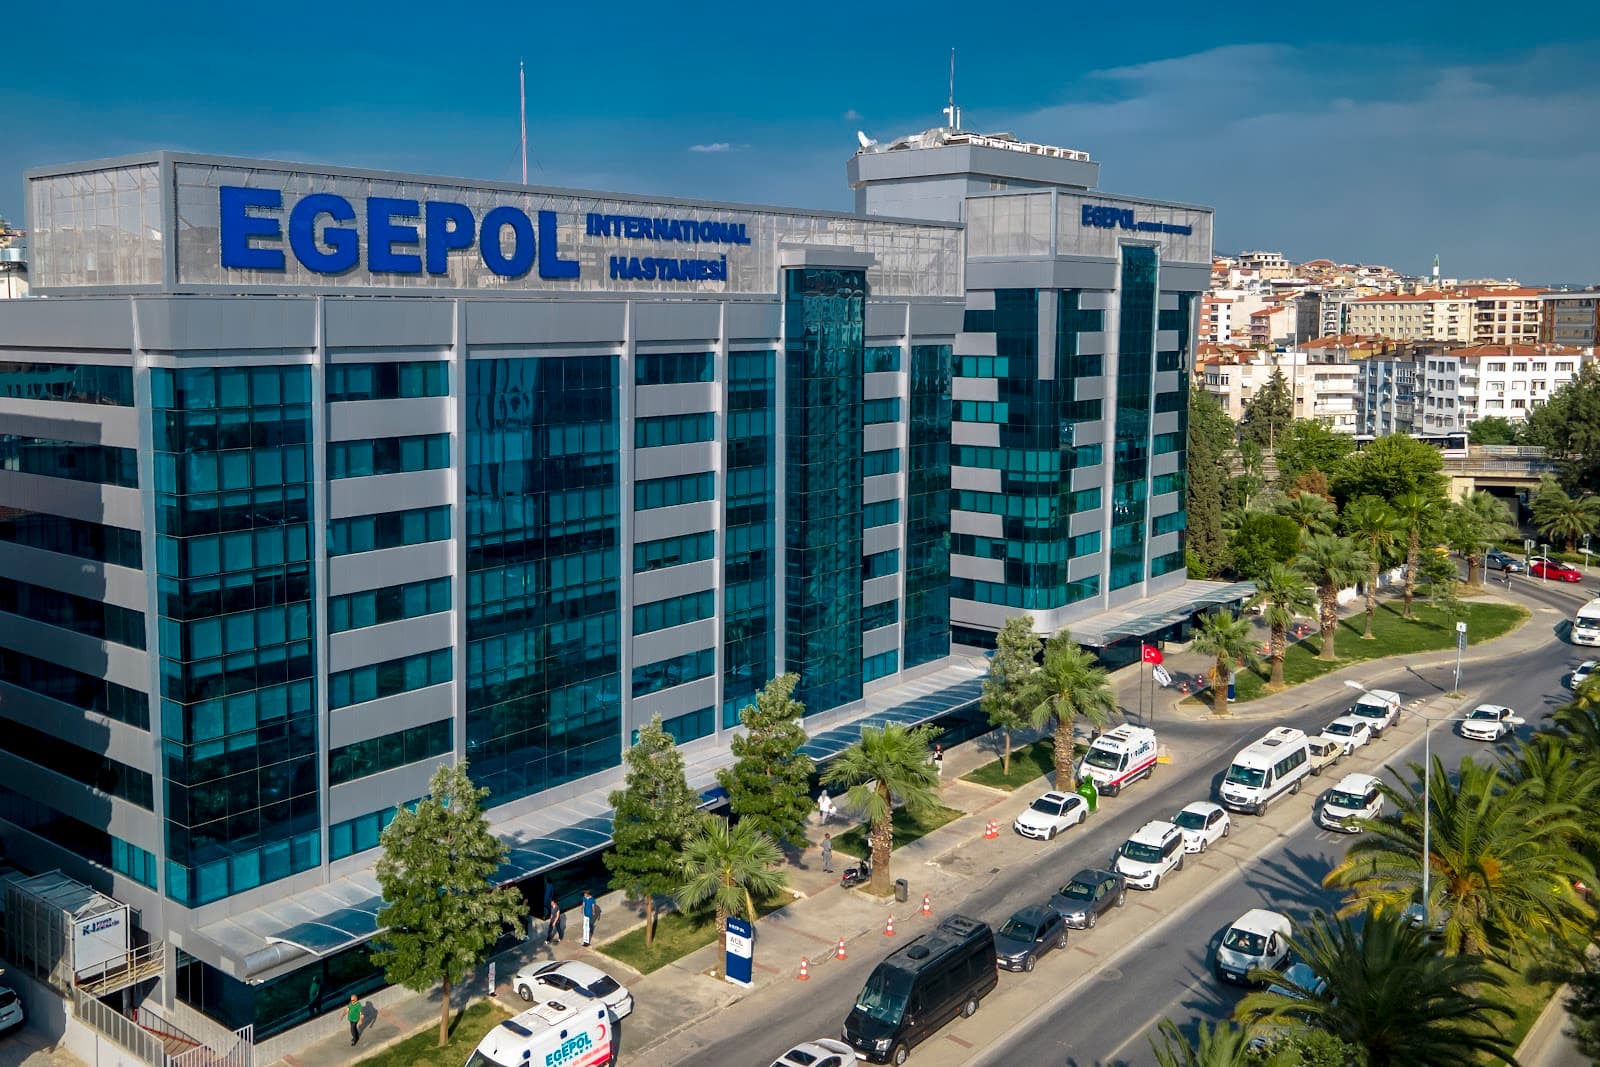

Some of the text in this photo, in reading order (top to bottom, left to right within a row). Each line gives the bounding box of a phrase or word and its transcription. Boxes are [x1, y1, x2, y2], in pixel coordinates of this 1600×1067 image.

[219, 186, 580, 280] EGEPOL
[586, 213, 751, 245] INTERNATIONAL
[610, 254, 727, 282] HASTANESİ
[545, 1034, 592, 1067] EGEPOL
